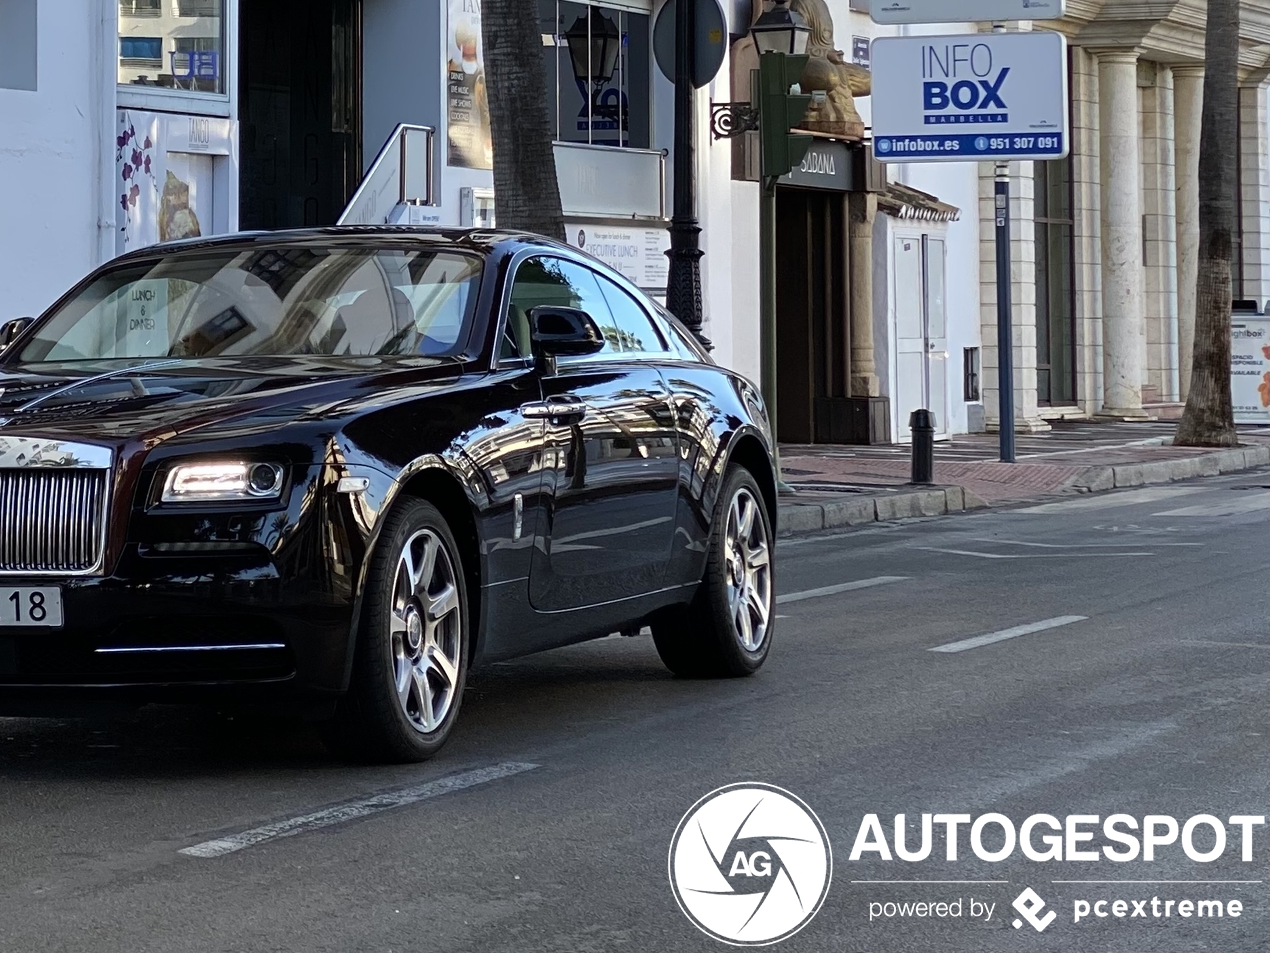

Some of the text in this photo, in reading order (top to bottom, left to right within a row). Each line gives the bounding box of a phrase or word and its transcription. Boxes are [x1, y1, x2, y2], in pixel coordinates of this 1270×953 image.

[922, 44, 993, 78] INFO
[923, 67, 1011, 111] BOX
[929, 115, 1003, 123] MARBELLA
[189, 118, 209, 143] TANGO
[892, 138, 960, 152] infobox.es
[990, 138, 1009, 149] 951
[1014, 138, 1033, 149] 307
[1038, 137, 1058, 148] 091
[618, 244, 638, 258] LUNCH
